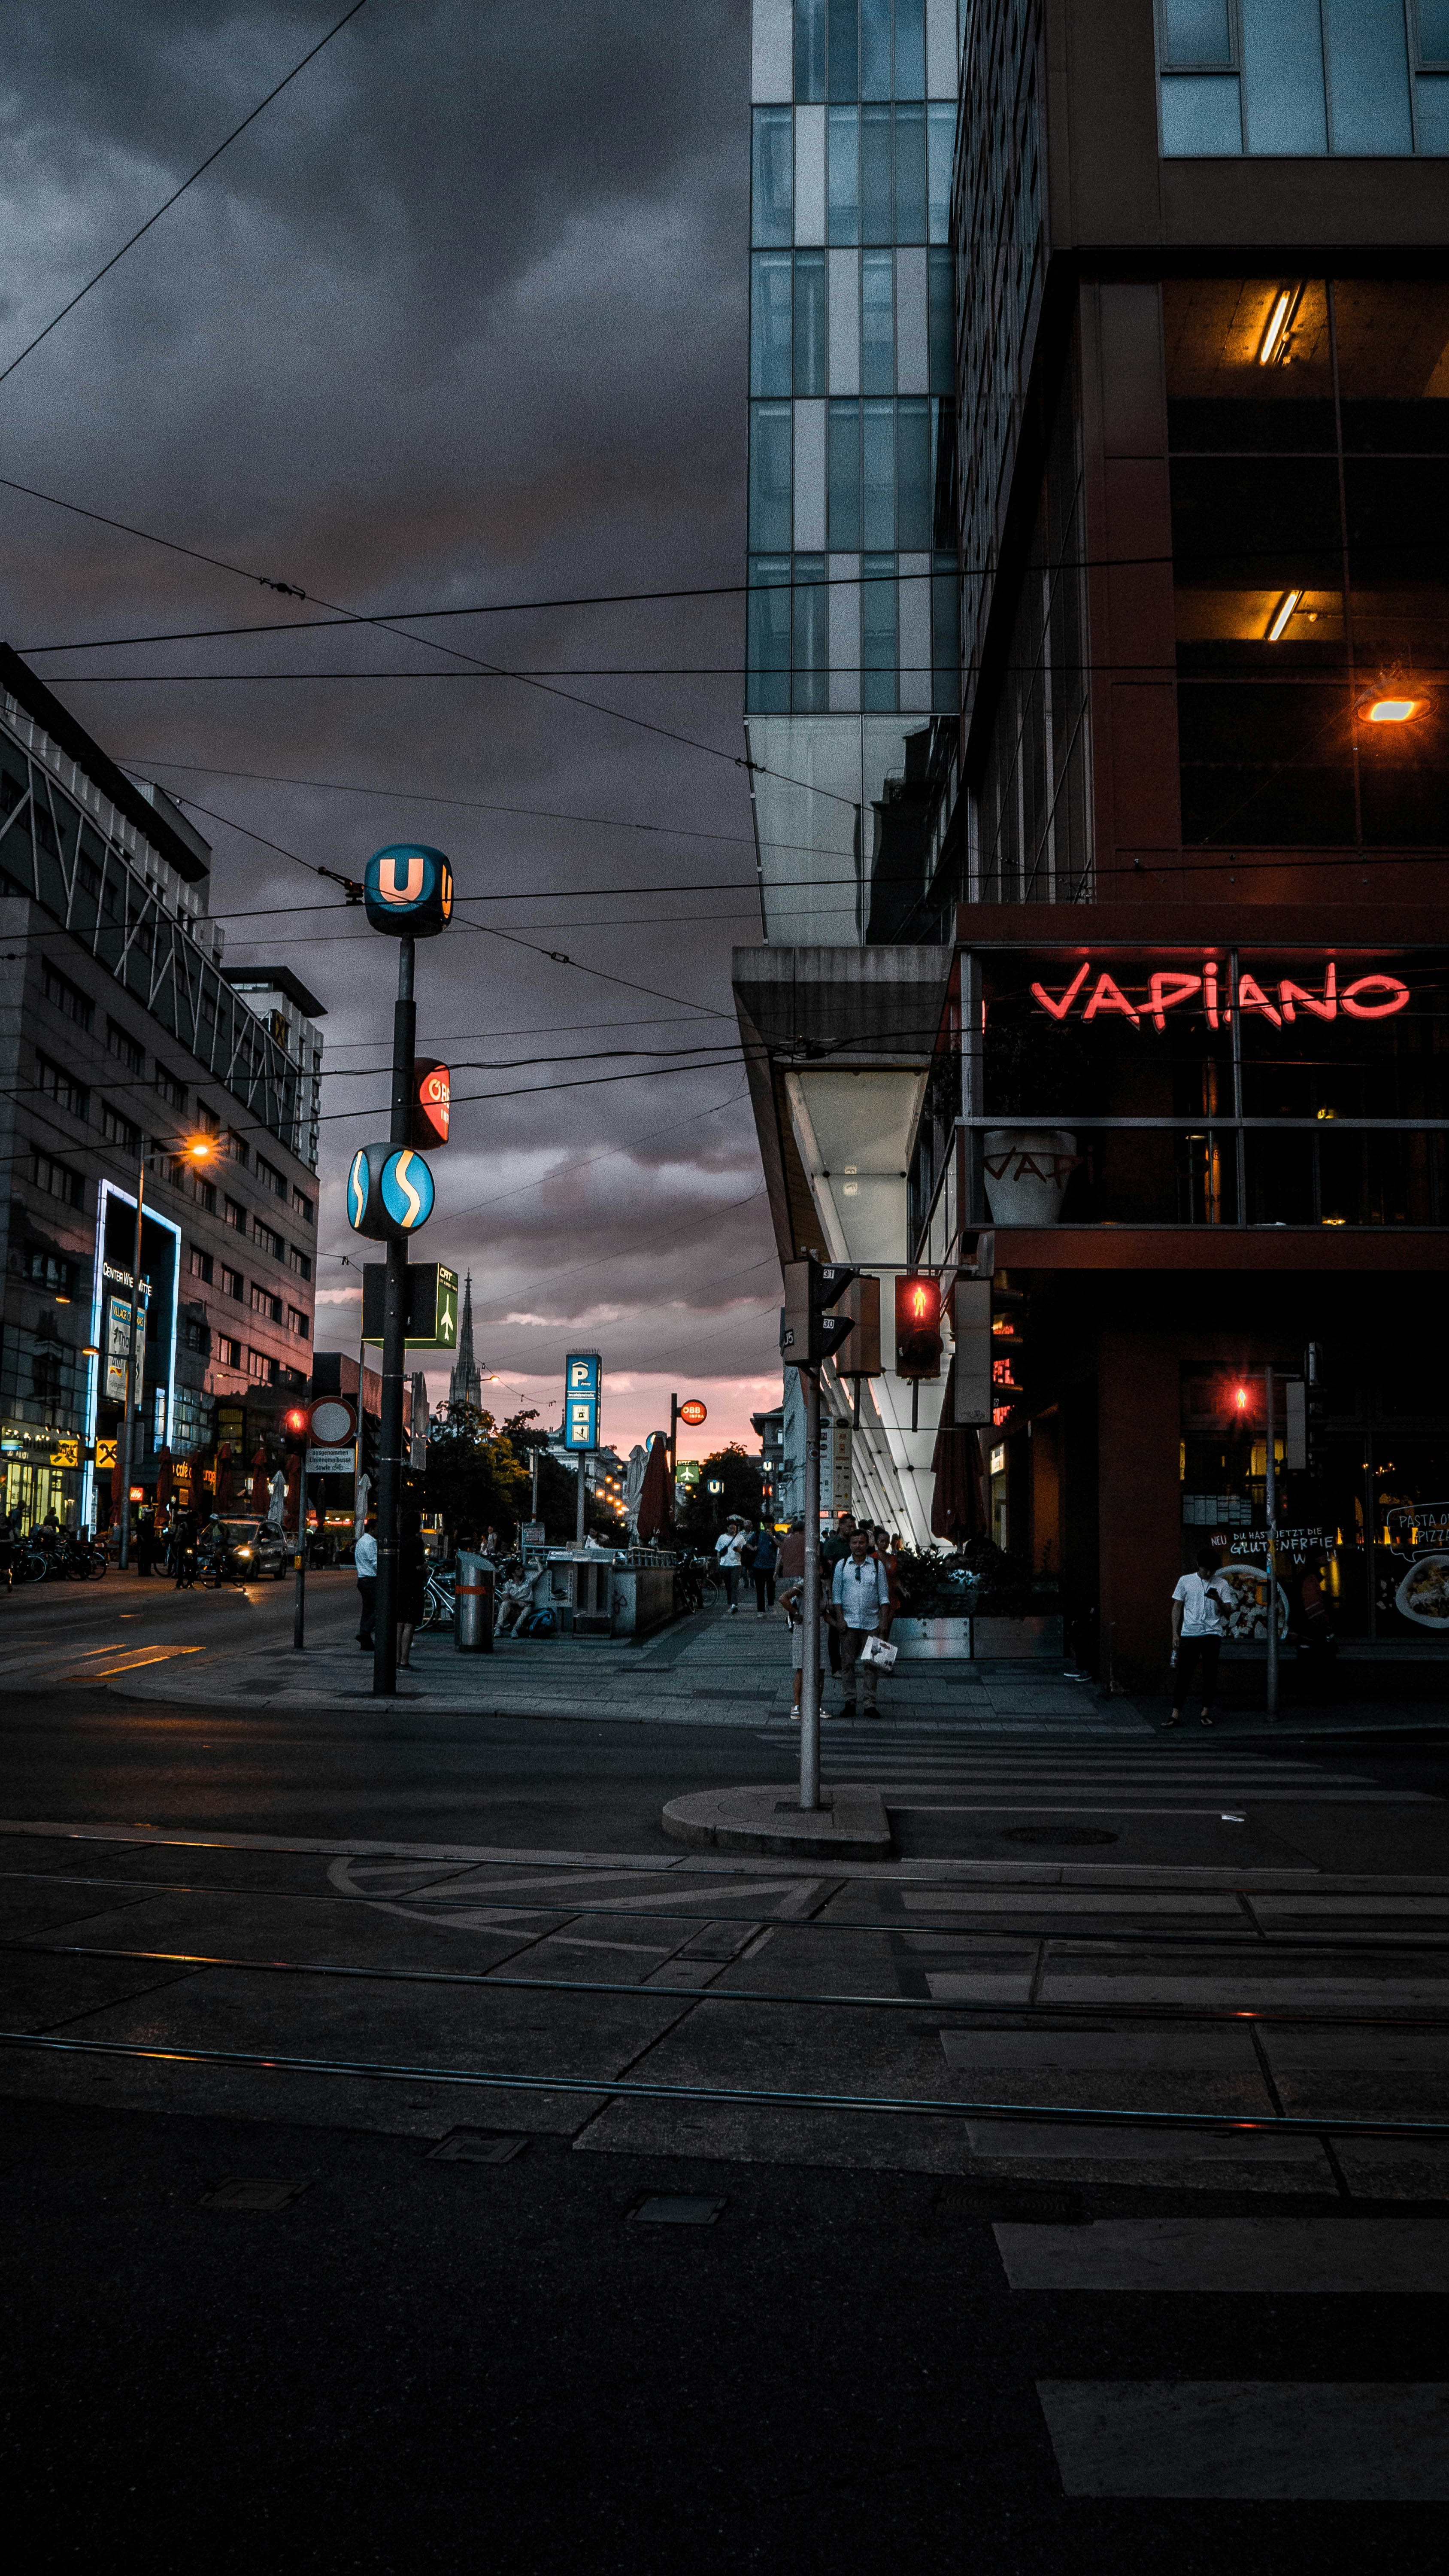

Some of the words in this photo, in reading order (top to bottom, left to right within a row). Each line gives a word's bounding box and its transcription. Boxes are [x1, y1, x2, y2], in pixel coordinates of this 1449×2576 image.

[380, 858, 424, 905] U
[103, 1261, 123, 1284] CENTER
[124, 1271, 133, 1288] WIE
[440, 1267, 453, 1282] CAT
[824, 1270, 834, 1278] 31
[824, 1319, 834, 1327] 30
[572, 1367, 588, 1387] P
[176, 1460, 188, 1478] café
[764, 1461, 772, 1470] U
[709, 1482, 720, 1493] U
[1399, 1513, 1437, 1528] PASTA
[1307, 1527, 1323, 1536] DIE
[1211, 1534, 1227, 1546] NEU
